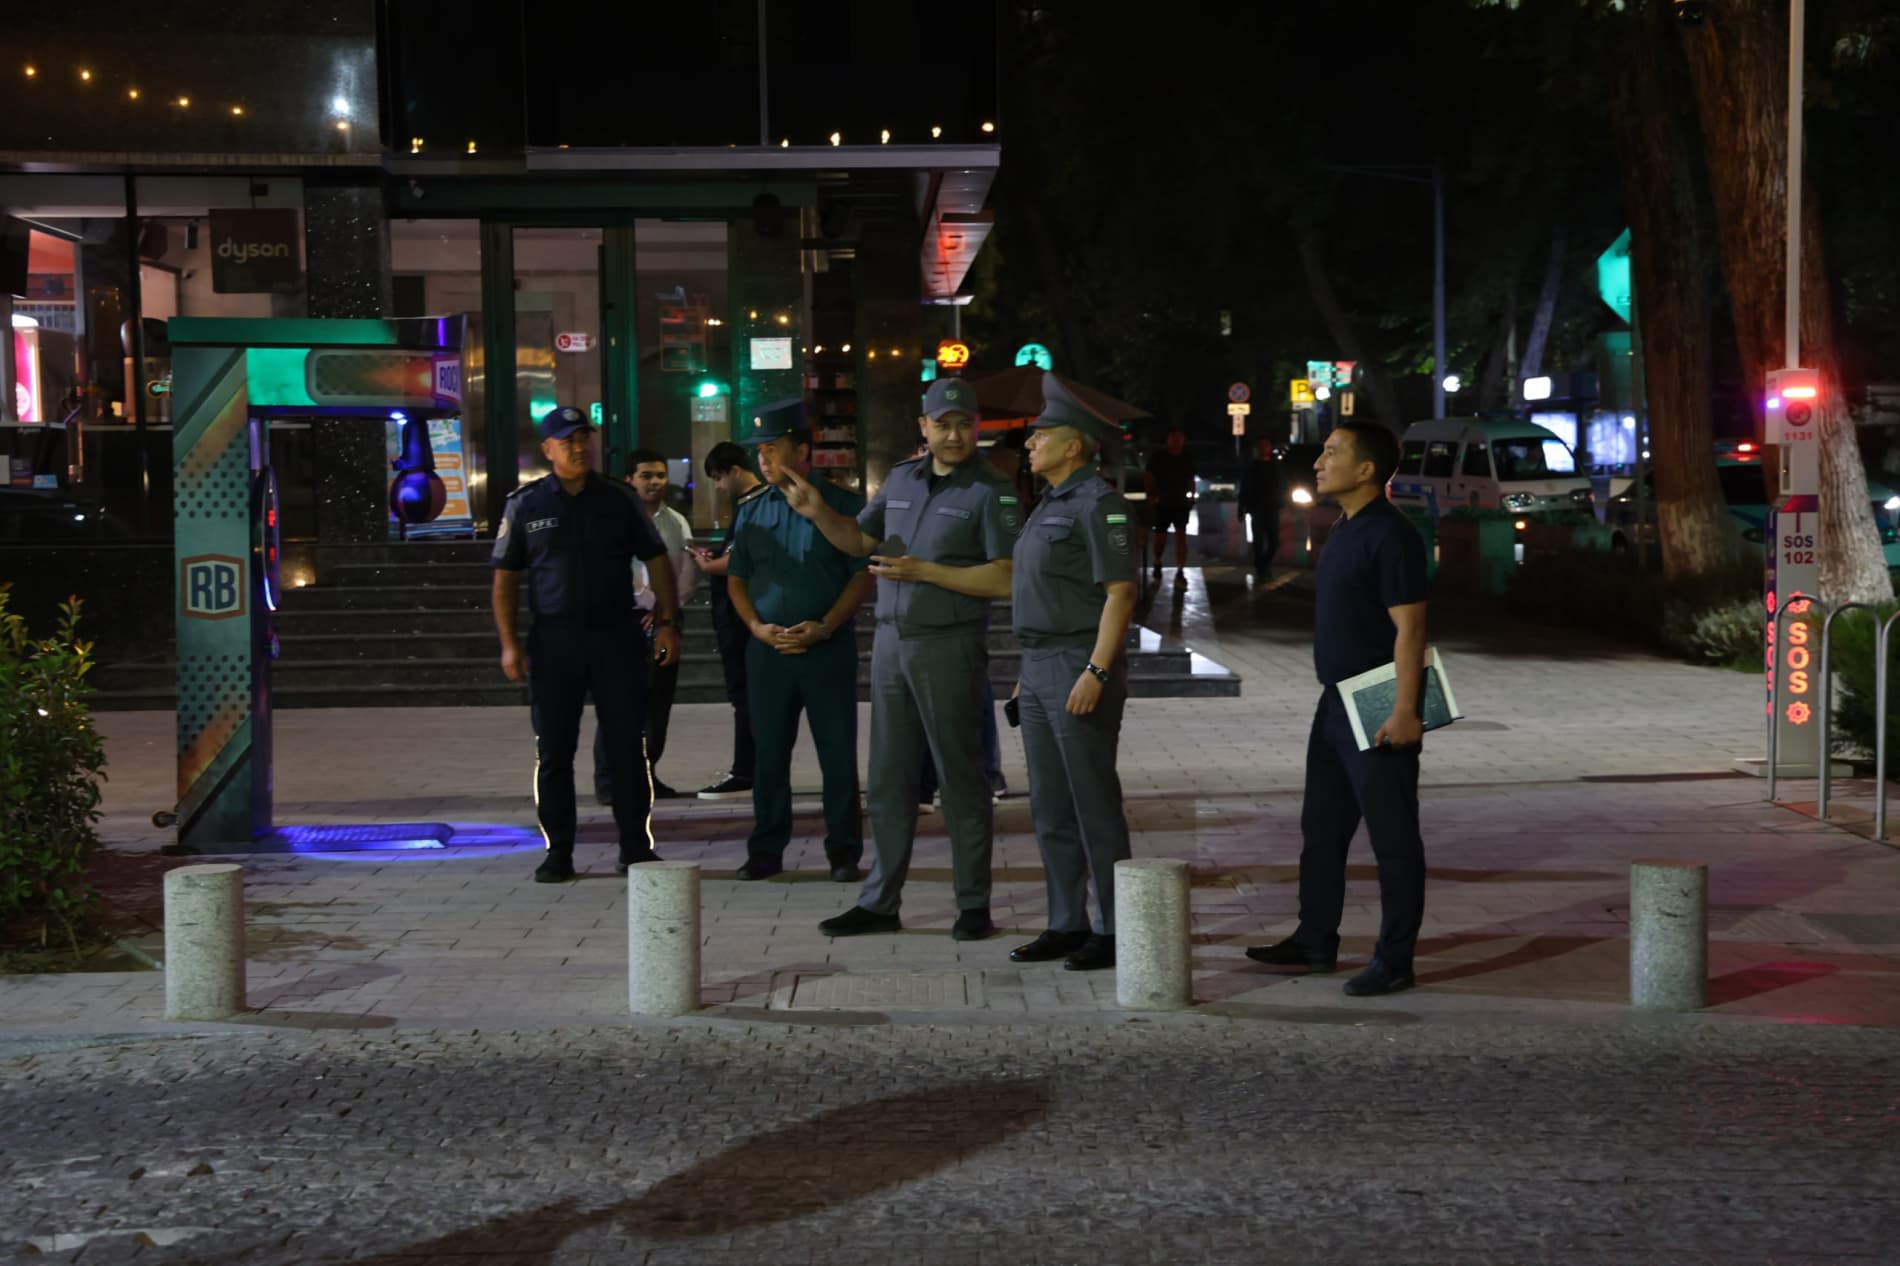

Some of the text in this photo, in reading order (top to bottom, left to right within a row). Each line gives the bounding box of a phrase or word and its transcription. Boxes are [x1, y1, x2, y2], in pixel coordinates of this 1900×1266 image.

[218, 236, 289, 264] dyson
[1783, 536, 1814, 548] SOS
[1784, 552, 1814, 564] 102
[191, 565, 236, 610] RB
[1787, 622, 1809, 694] SOS
